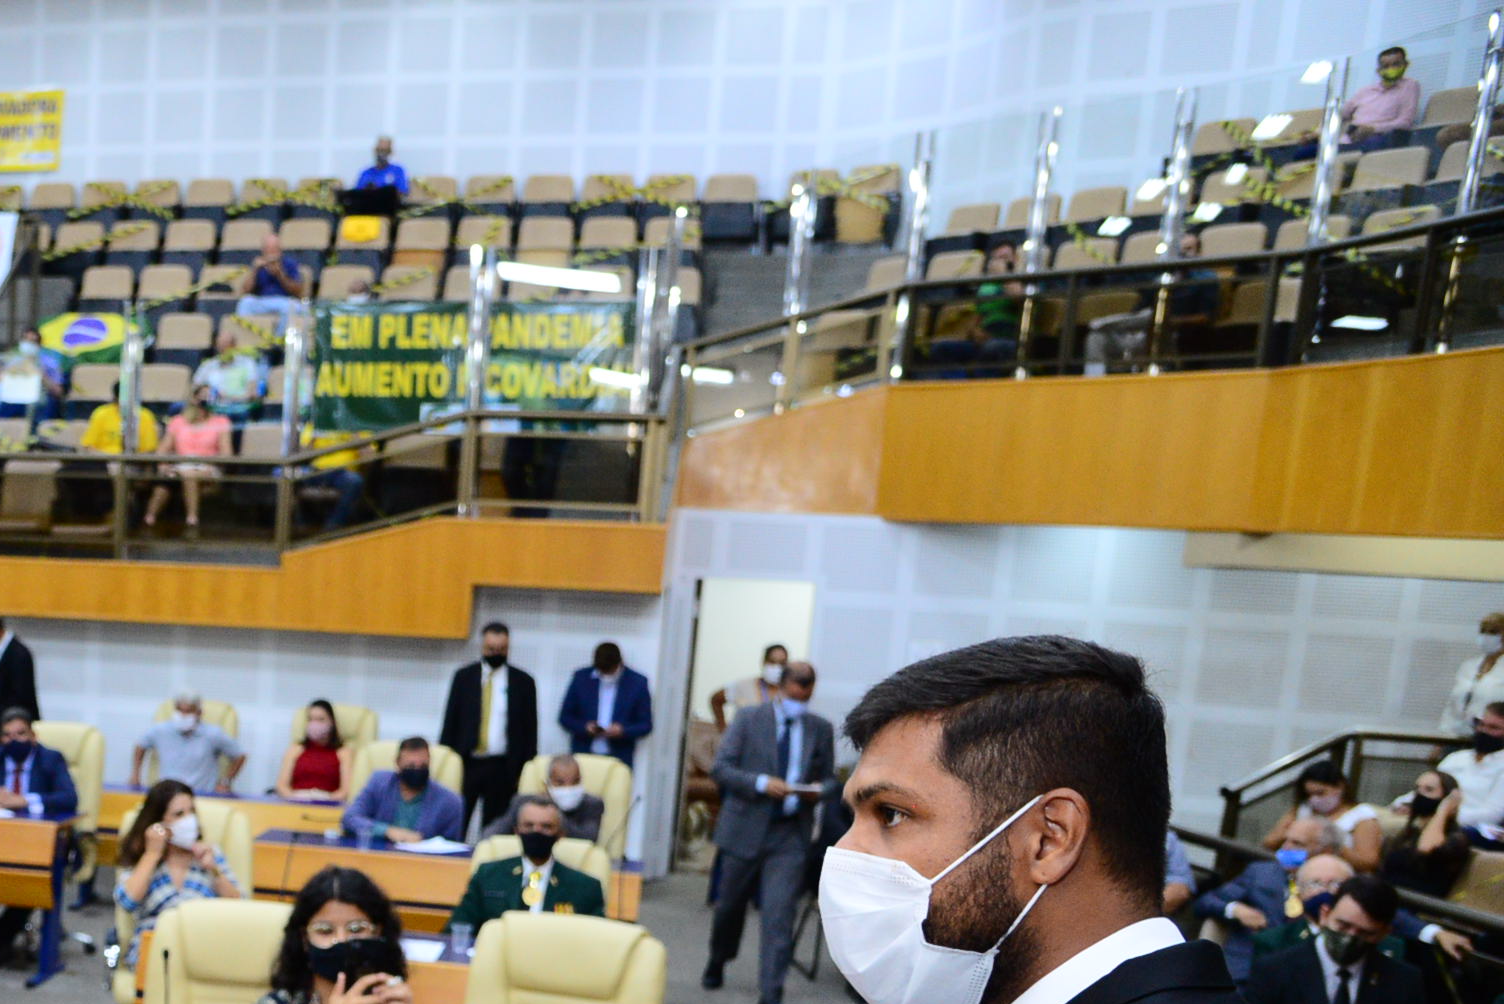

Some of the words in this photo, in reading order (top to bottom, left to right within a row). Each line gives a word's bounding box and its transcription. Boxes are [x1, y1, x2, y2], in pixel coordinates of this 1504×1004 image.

[331, 313, 374, 349] EM
[378, 313, 469, 349] PLENA
[315, 360, 450, 399] AUMENTO
